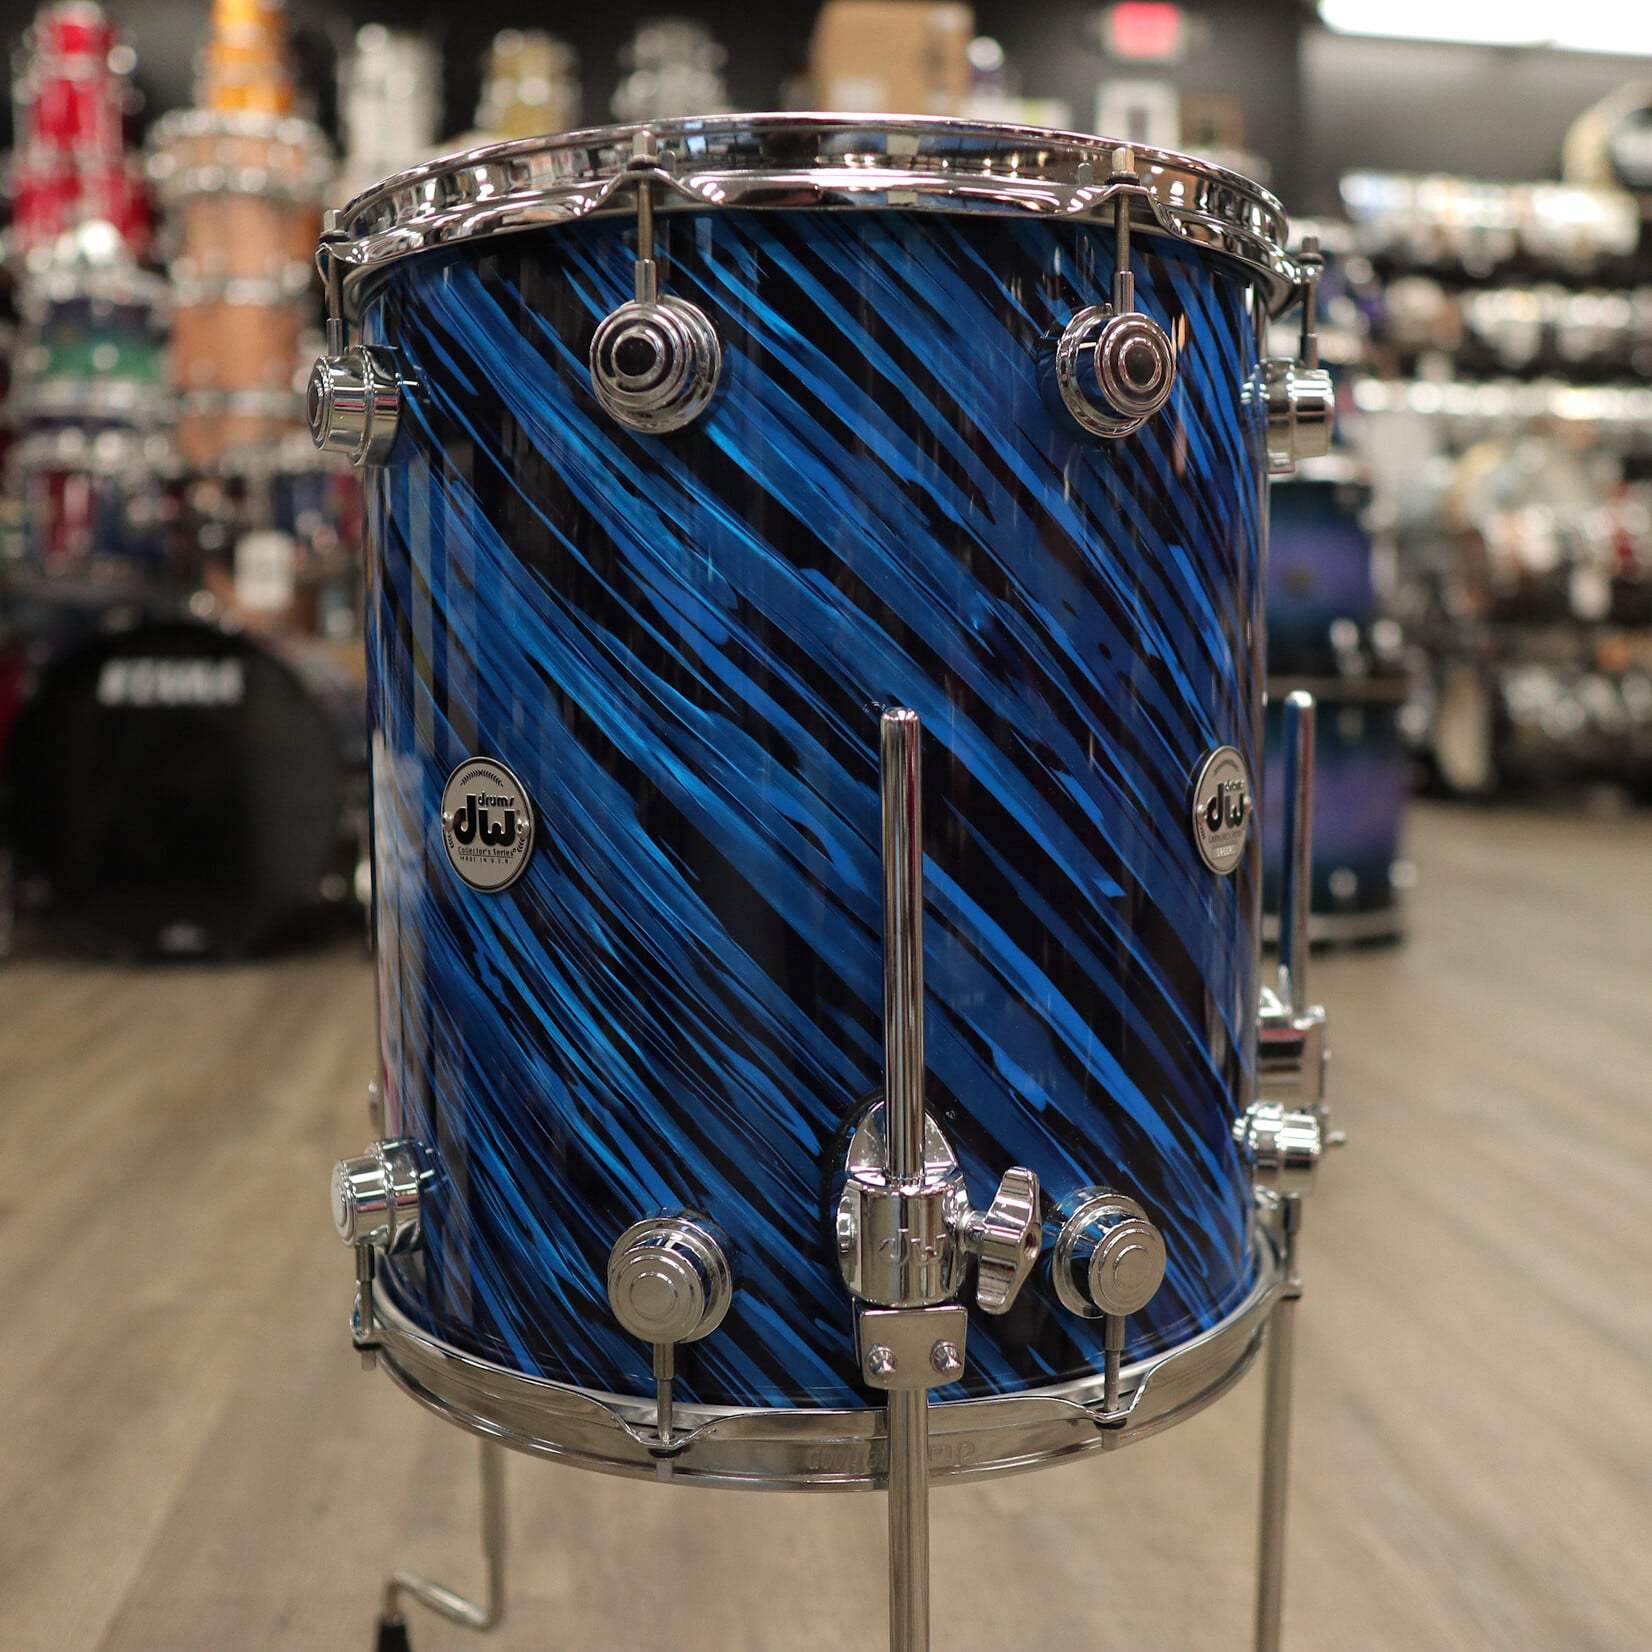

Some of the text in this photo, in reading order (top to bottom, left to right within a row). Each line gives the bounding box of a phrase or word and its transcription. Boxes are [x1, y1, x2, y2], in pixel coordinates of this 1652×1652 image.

[478, 791, 515, 807] drums
[1207, 782, 1244, 832] dw
[453, 794, 516, 847] dw
[458, 846, 491, 855] Collector's
